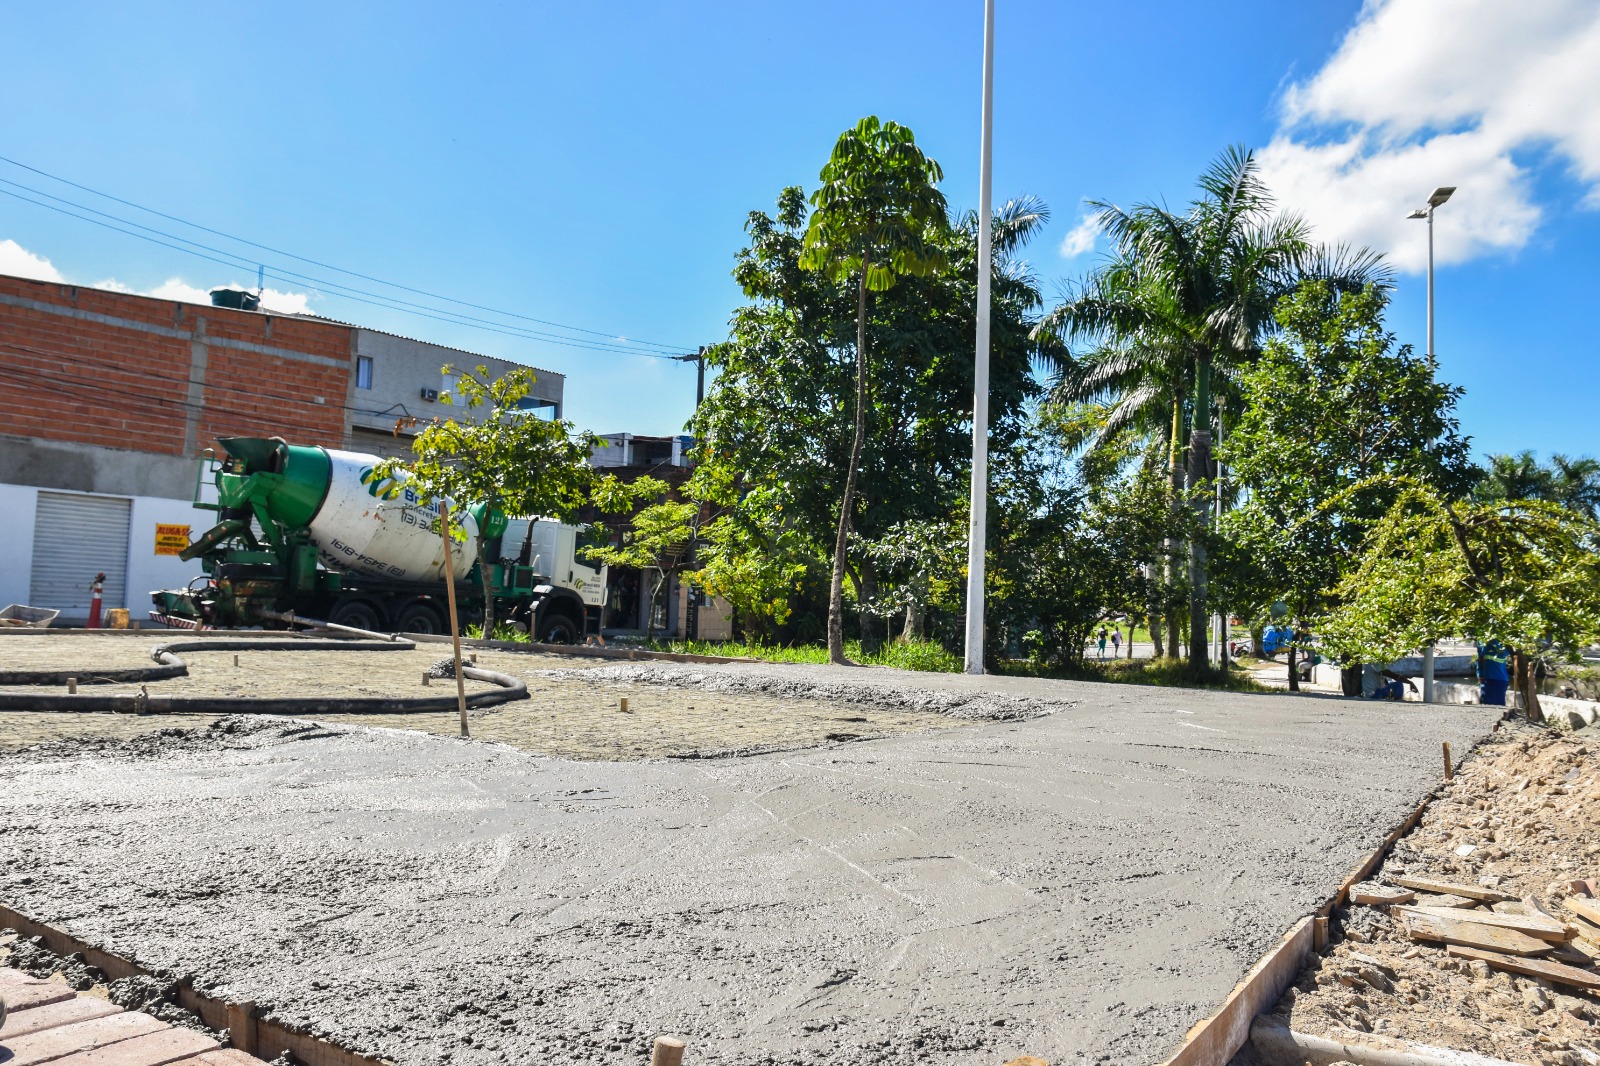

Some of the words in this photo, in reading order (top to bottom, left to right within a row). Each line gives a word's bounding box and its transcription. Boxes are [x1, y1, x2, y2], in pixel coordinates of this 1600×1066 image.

[401, 512, 417, 527] (13)
[404, 503, 437, 521] concret
[491, 516, 504, 525] 121
